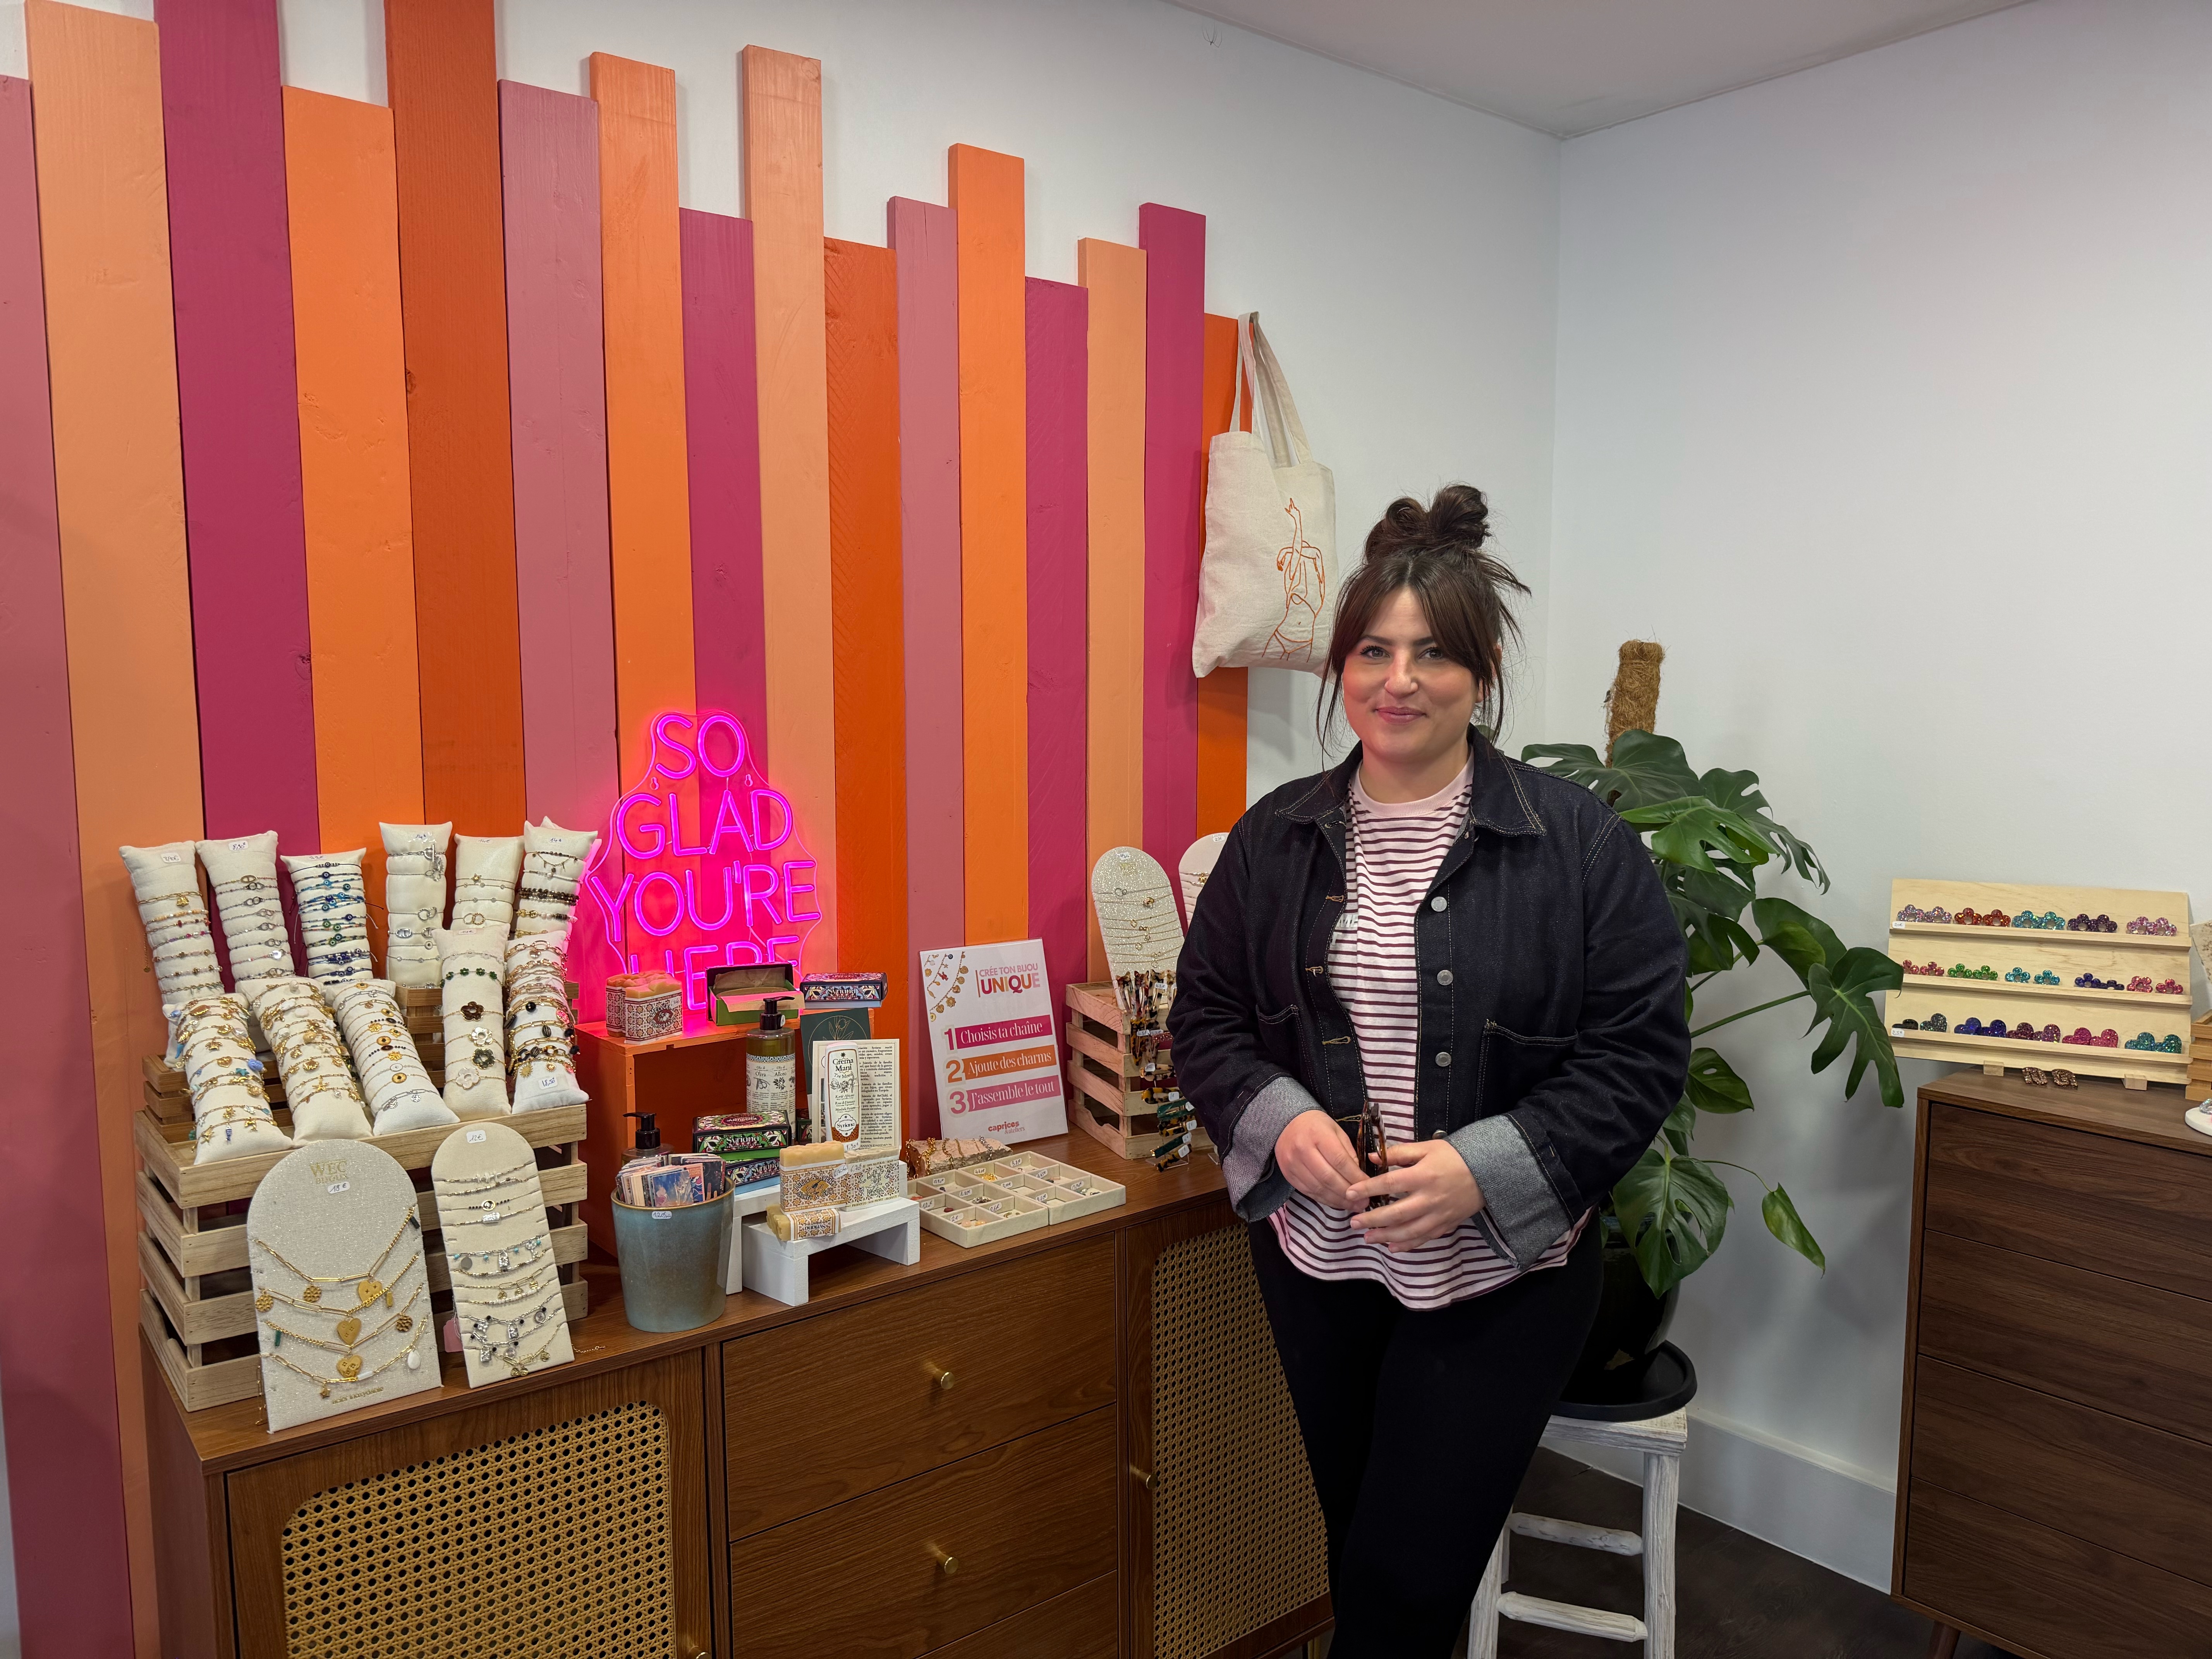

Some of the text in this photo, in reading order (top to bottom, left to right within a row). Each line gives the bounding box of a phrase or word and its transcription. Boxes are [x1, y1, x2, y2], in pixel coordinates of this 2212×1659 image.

[655, 715, 745, 779] SO
[616, 790, 792, 859] GLAD
[591, 861, 821, 941] YOU'RE
[979, 963, 1038, 977] CRÉE TON BIJOU
[981, 972, 1041, 994] UNIQUE
[944, 1021, 1042, 1050] 1 Choisis ta chaîne
[946, 1052, 1051, 1083] 2 Ajoute des charms
[950, 1080, 1054, 1114] 3 J'assemble le tout
[469, 1134, 483, 1142] 12€
[988, 1121, 1019, 1132] caprices
[726, 1135, 759, 1145] Syriana
[310, 1161, 347, 1177] WEC
